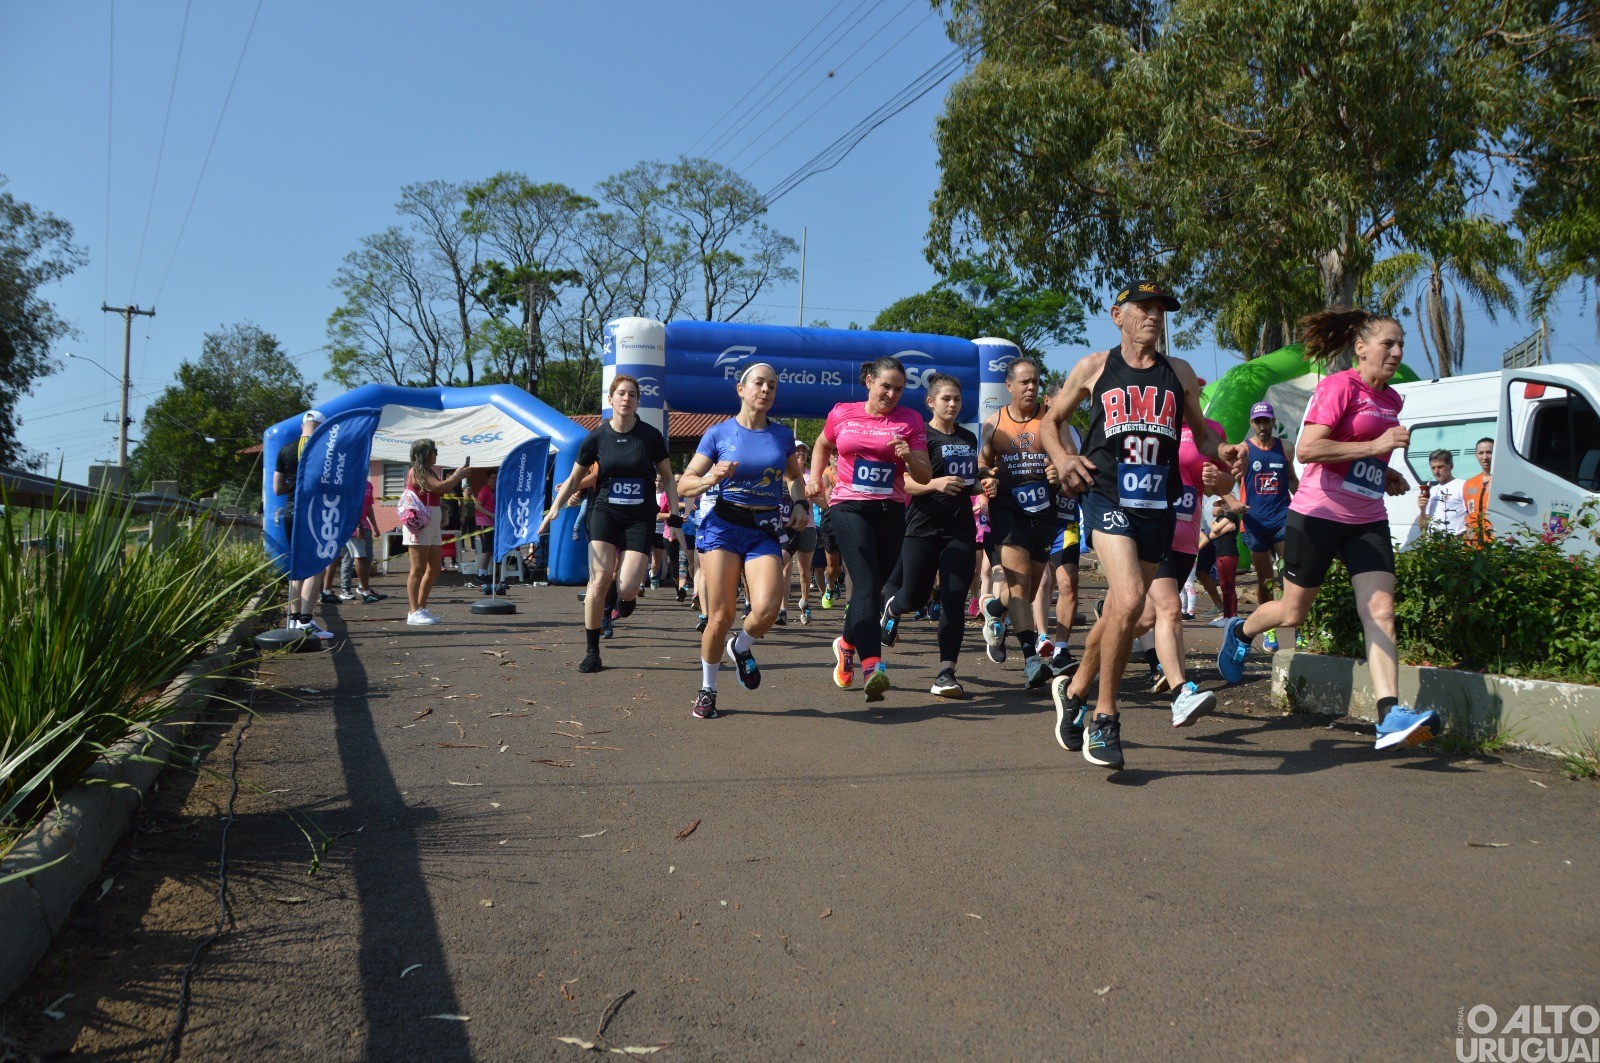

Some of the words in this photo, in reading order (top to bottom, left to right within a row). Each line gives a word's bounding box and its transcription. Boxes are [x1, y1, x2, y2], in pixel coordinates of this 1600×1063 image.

[724, 365, 817, 385] Feércio
[820, 371, 842, 386] RS
[639, 384, 660, 396] esc
[1101, 385, 1177, 431] RMA
[1104, 425, 1122, 439] REDE
[1122, 424, 1147, 434] MESTRE
[320, 423, 340, 484] Fecomércio
[1123, 434, 1160, 466] 30
[334, 452, 347, 485] Senac
[857, 465, 892, 482] 057
[948, 461, 973, 475] 011
[1353, 461, 1383, 486] 008
[525, 471, 533, 492] Senac
[612, 482, 641, 495] 052
[1123, 472, 1163, 493] 047
[1017, 486, 1046, 504] 019
[778, 503, 790, 514] 20
